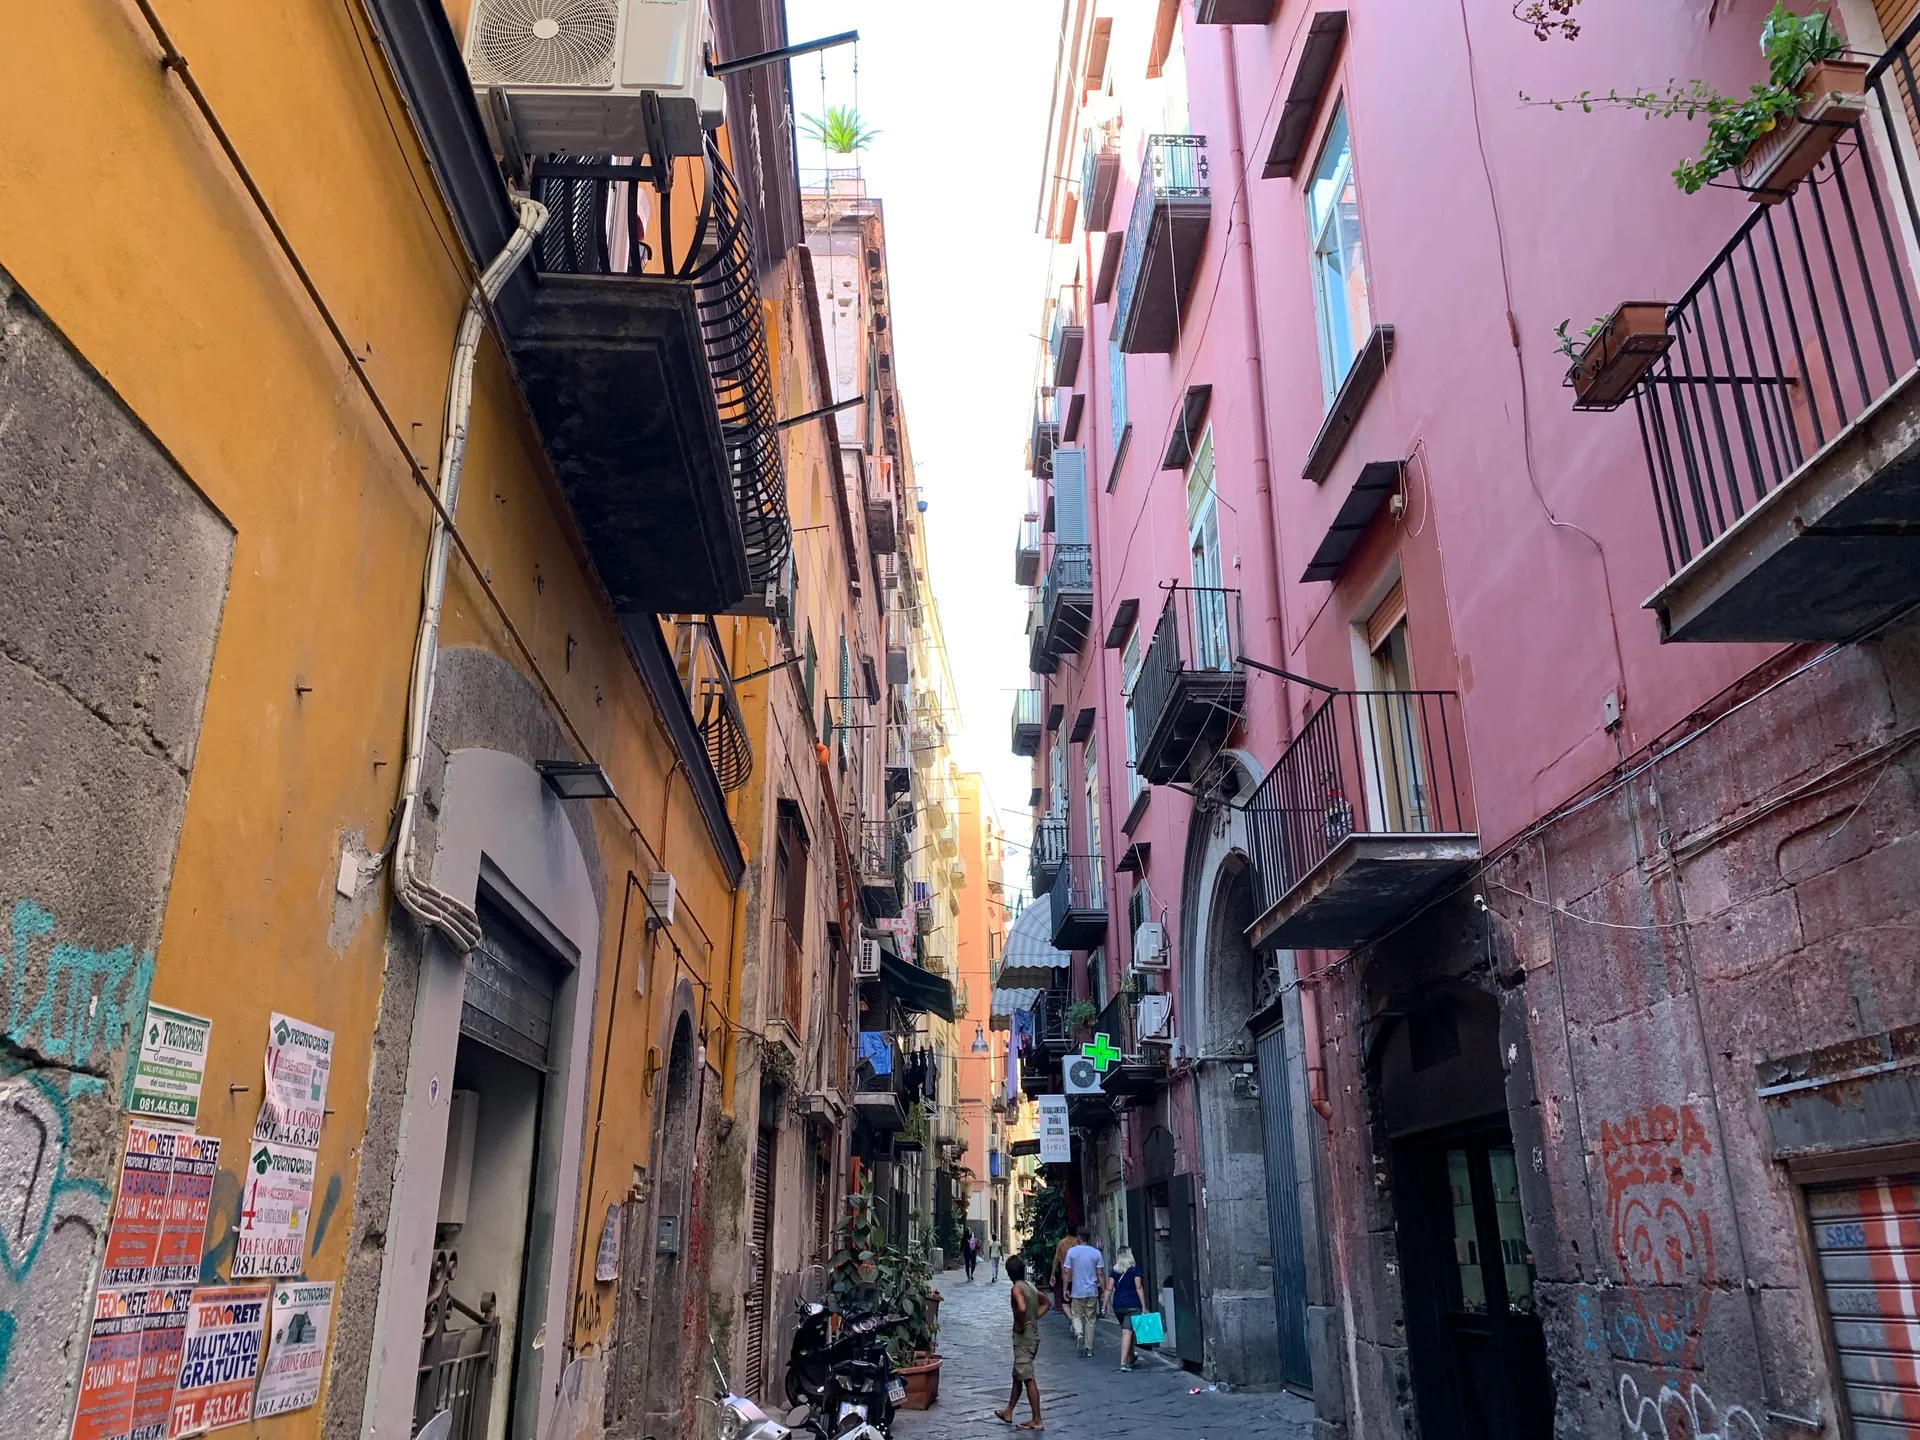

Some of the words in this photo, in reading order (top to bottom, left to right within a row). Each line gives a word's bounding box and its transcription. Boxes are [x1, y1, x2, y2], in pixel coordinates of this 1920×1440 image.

[290, 1028, 329, 1054] TECNOCASA
[143, 1063, 176, 1077] VALUTAZIONE
[176, 1069, 198, 1081] GRATUITA
[139, 1097, 190, 1115] 081.44.63.49
[255, 1119, 320, 1147] 081.44.63.49
[148, 1157, 172, 1173] VENDITA
[193, 1162, 215, 1176] VENDITA
[272, 1154, 312, 1176] TECNOCASA
[232, 1255, 300, 1276] 081.44.63.49
[187, 1330, 262, 1363] VALUTAZIONI
[180, 1354, 258, 1390] GRATUITE
